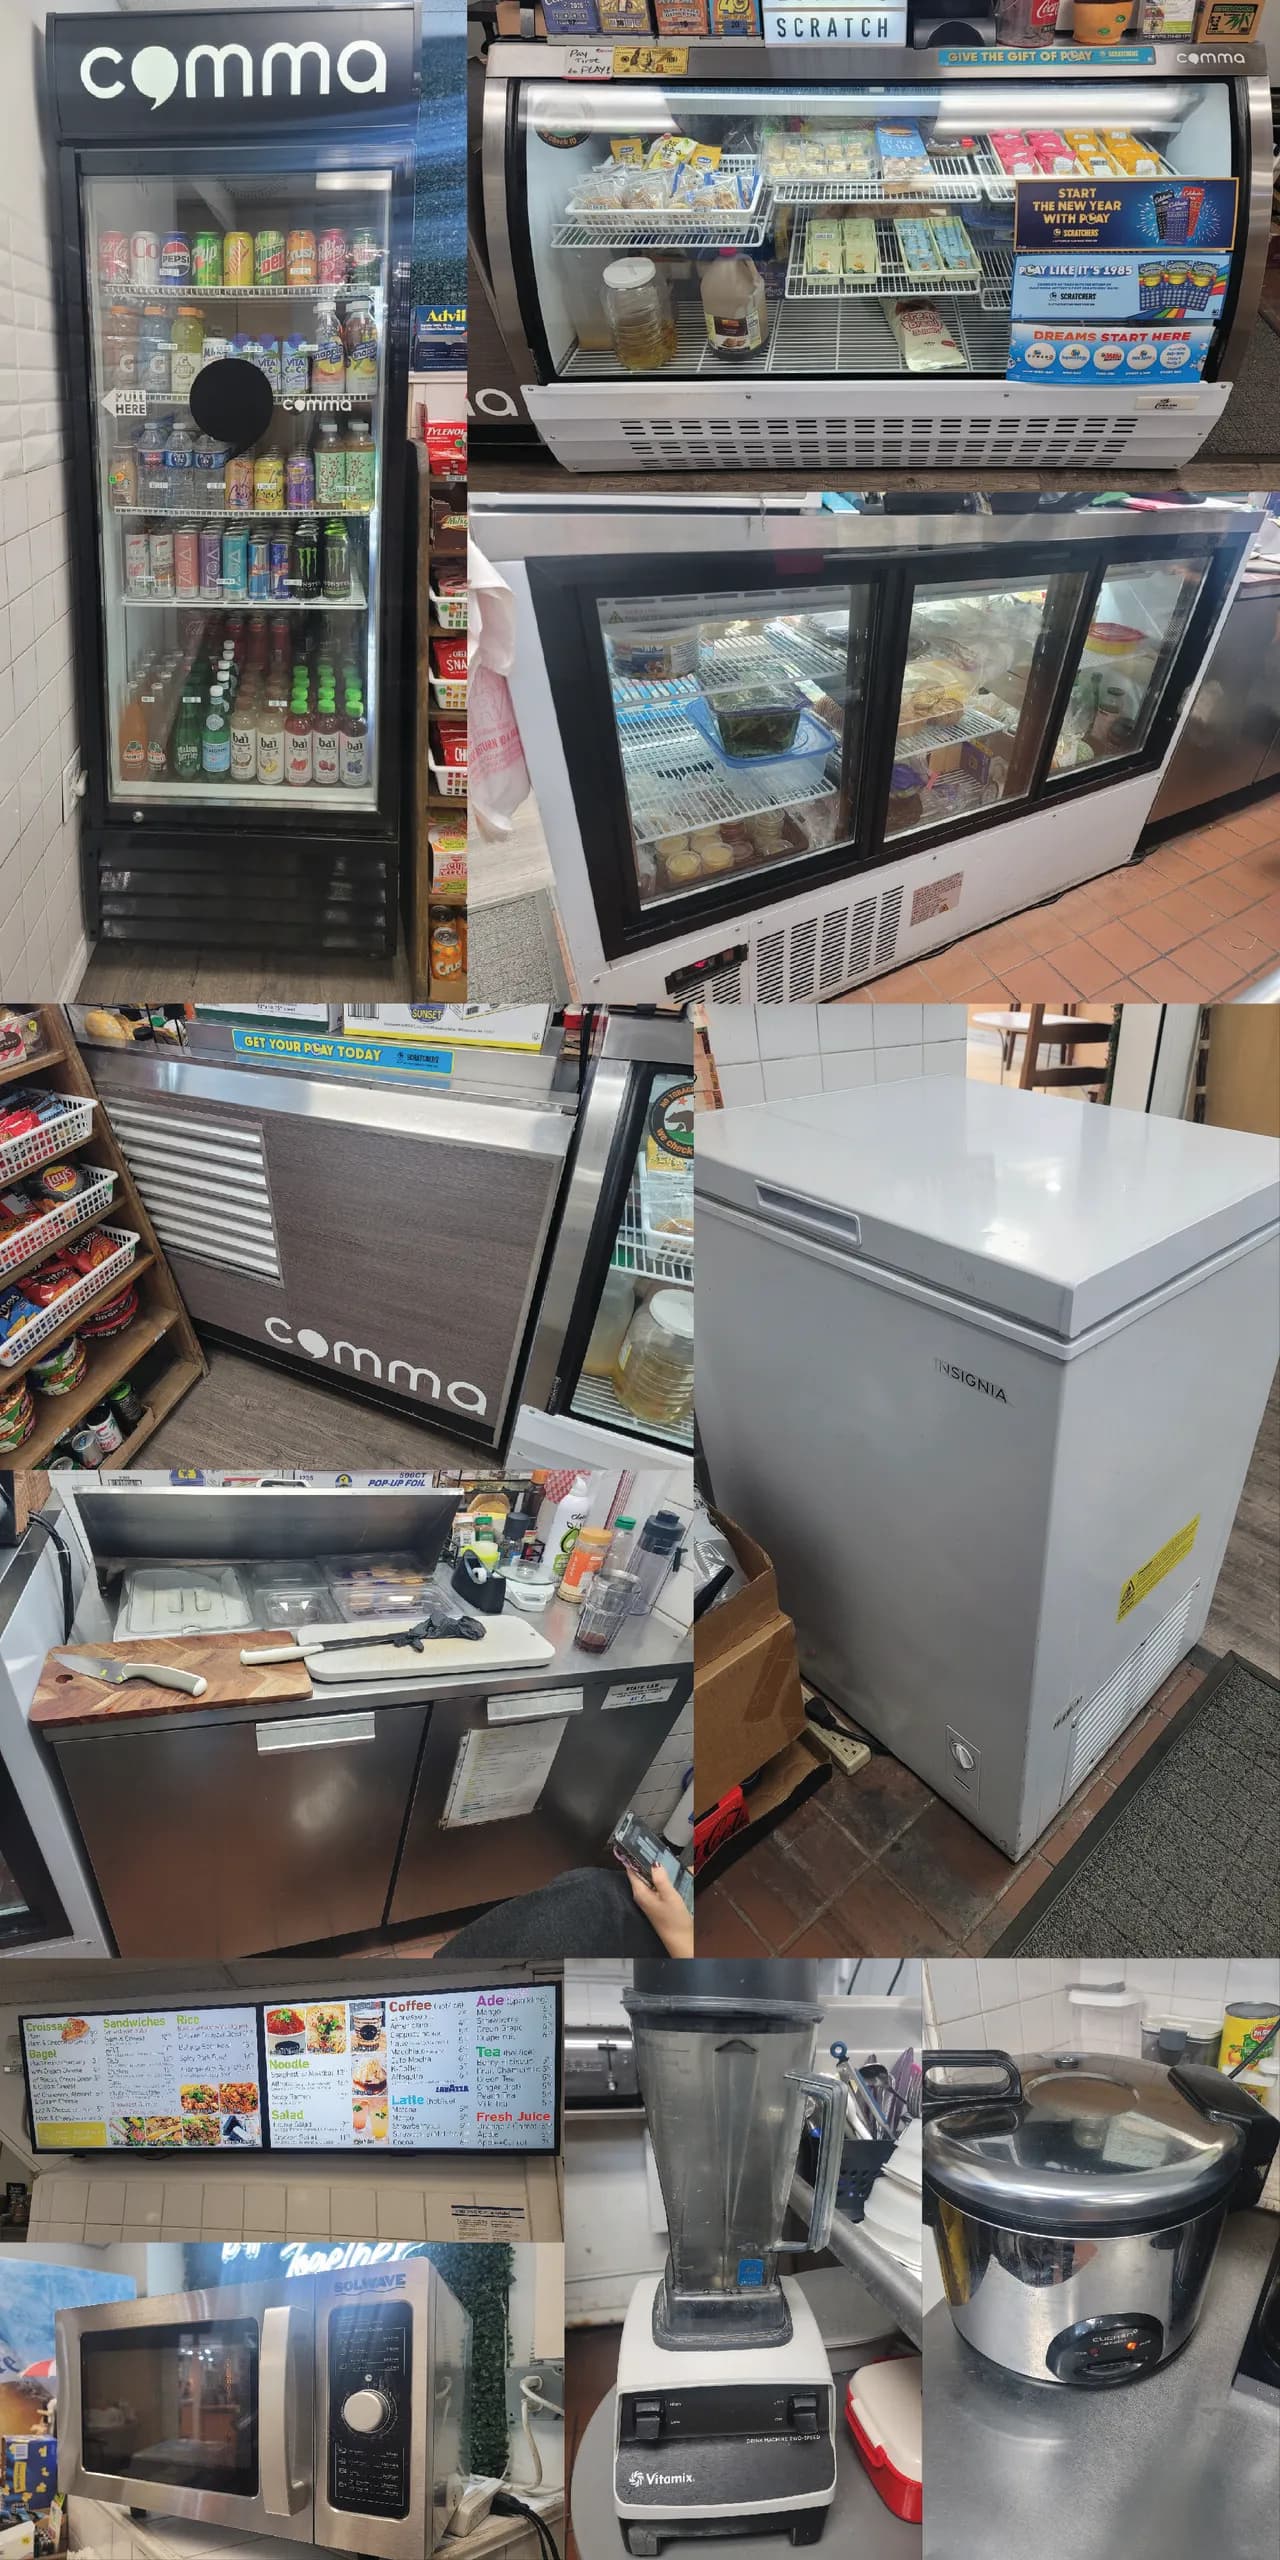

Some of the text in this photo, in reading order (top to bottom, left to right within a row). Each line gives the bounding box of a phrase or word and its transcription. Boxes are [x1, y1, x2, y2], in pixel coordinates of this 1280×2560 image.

[776, 17, 888, 38] SCRATCH
[948, 52, 978, 62] GIVE
[981, 52, 1010, 62] THE
[1009, 52, 1036, 61] GIFT
[1040, 51, 1056, 61] OF
[1176, 51, 1246, 65] comma
[80, 39, 387, 111] comma
[1058, 187, 1097, 199] START
[1032, 200, 1122, 211] THE NEW YEAR
[1043, 213, 1075, 224] WITH
[1063, 228, 1099, 237] SCRATCHERS
[162, 255, 190, 263] PEPSI
[1049, 264, 1076, 276] LIKE
[1076, 264, 1100, 276] IT'S
[1103, 264, 1133, 276] 1985
[1060, 292, 1097, 301] SCRATCHERS
[426, 309, 467, 323] Advil
[1033, 330, 1192, 343] DREAMS START HERE
[286, 358, 305, 366] VITA
[115, 391, 145, 402] PULL
[115, 404, 146, 414] HERE
[282, 399, 352, 412] comma
[232, 732, 249, 744] bai
[260, 737, 277, 749] bai
[292, 738, 307, 749] bai
[319, 737, 336, 749] bai
[347, 740, 363, 751] bai
[412, 1008, 442, 1021] SUNSET
[244, 1036, 266, 1047] GET
[269, 1038, 301, 1052] YOUR
[337, 1046, 382, 1061] TODAY
[45, 1166, 73, 1188] Lay's
[264, 1316, 486, 1417] comma
[933, 1358, 1007, 1404] INSIGNIA
[368, 1479, 426, 1487] POP-UP FOIL
[389, 1999, 433, 2013] Coffee
[476, 1994, 505, 2007] Ade
[103, 2016, 166, 2029] Sandwiches
[176, 2015, 199, 2025] Rice
[28, 2049, 57, 2061] Bagel
[475, 2046, 501, 2058] Tea
[269, 2059, 310, 2070] Noodle
[391, 2095, 425, 2105] Latte
[271, 2109, 304, 2120] Salad
[476, 2111, 551, 2122] Fresh Juice
[334, 2274, 406, 2293] SOLWAVE
[646, 2471, 693, 2486] Vitamix
